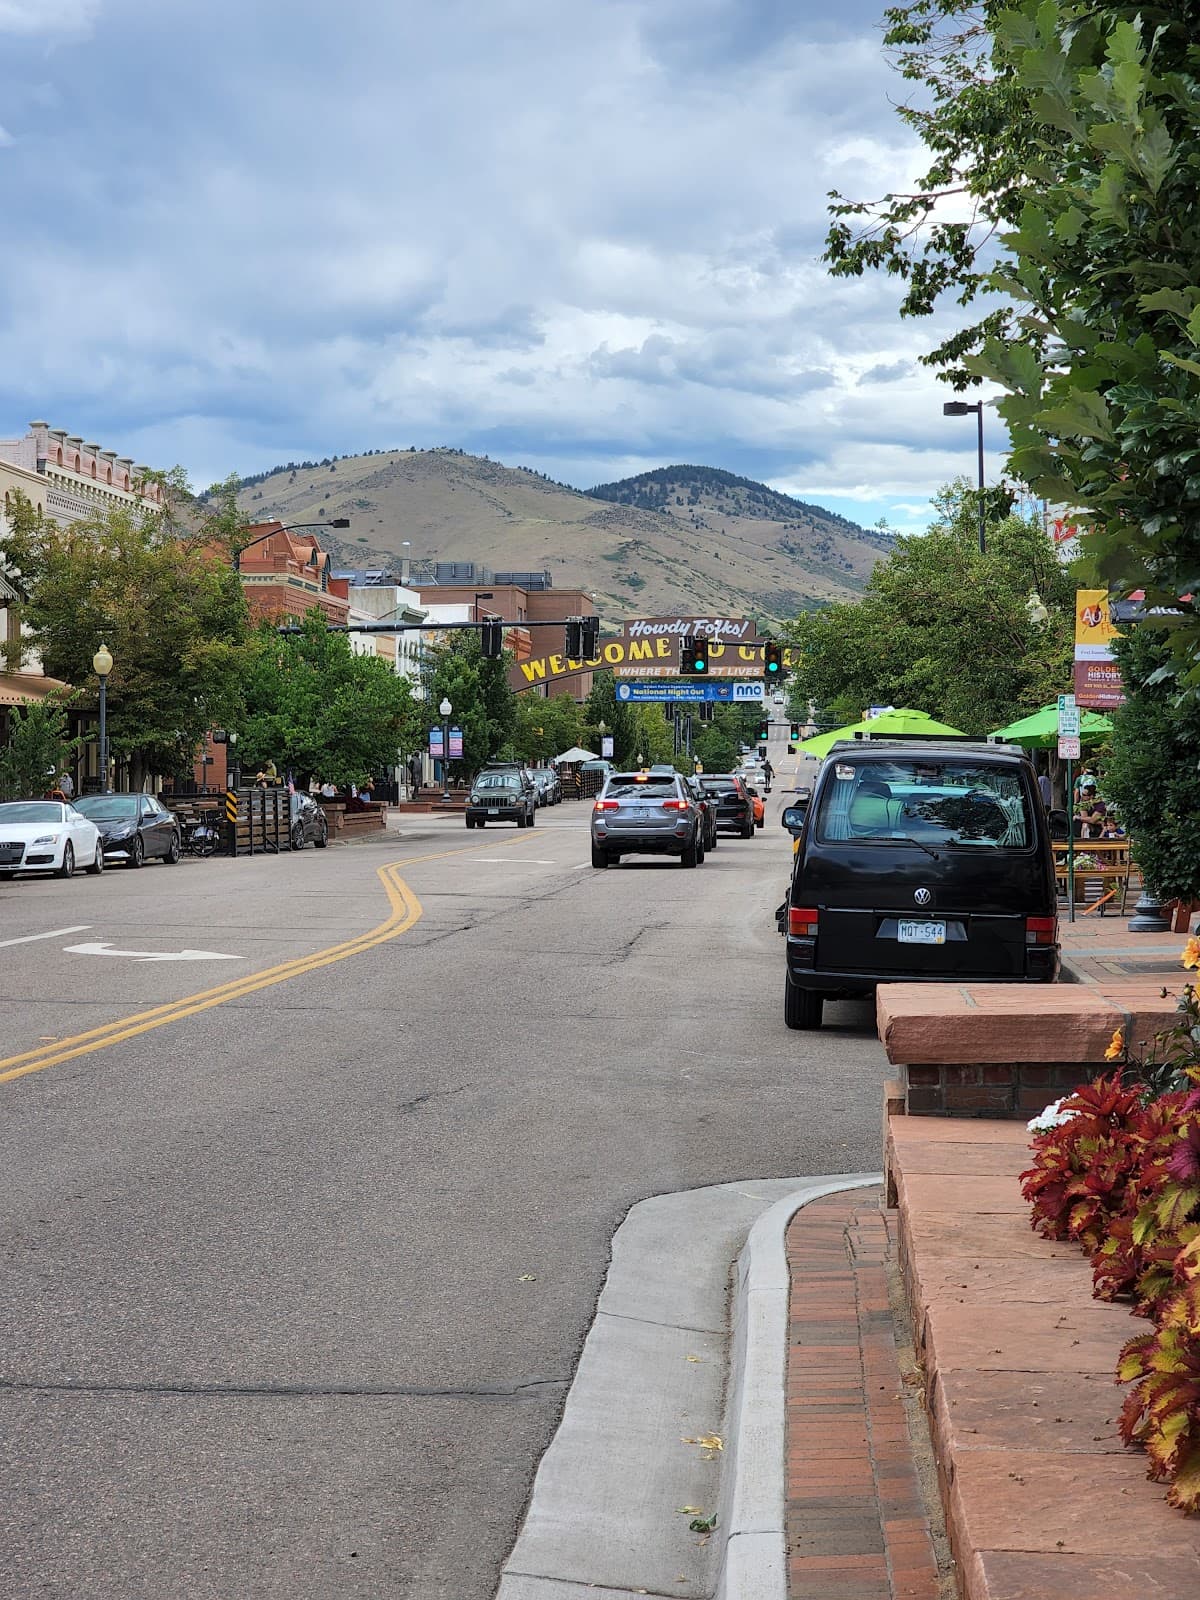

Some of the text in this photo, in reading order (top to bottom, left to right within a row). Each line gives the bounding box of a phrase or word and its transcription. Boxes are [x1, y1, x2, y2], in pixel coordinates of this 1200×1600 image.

[629, 619, 749, 638] Howdy Folks!
[619, 667, 662, 676] WHERE
[666, 667, 681, 676] TH
[728, 667, 760, 676] LIVES
[668, 689, 689, 697] Night
[1060, 698, 1065, 709] 2
